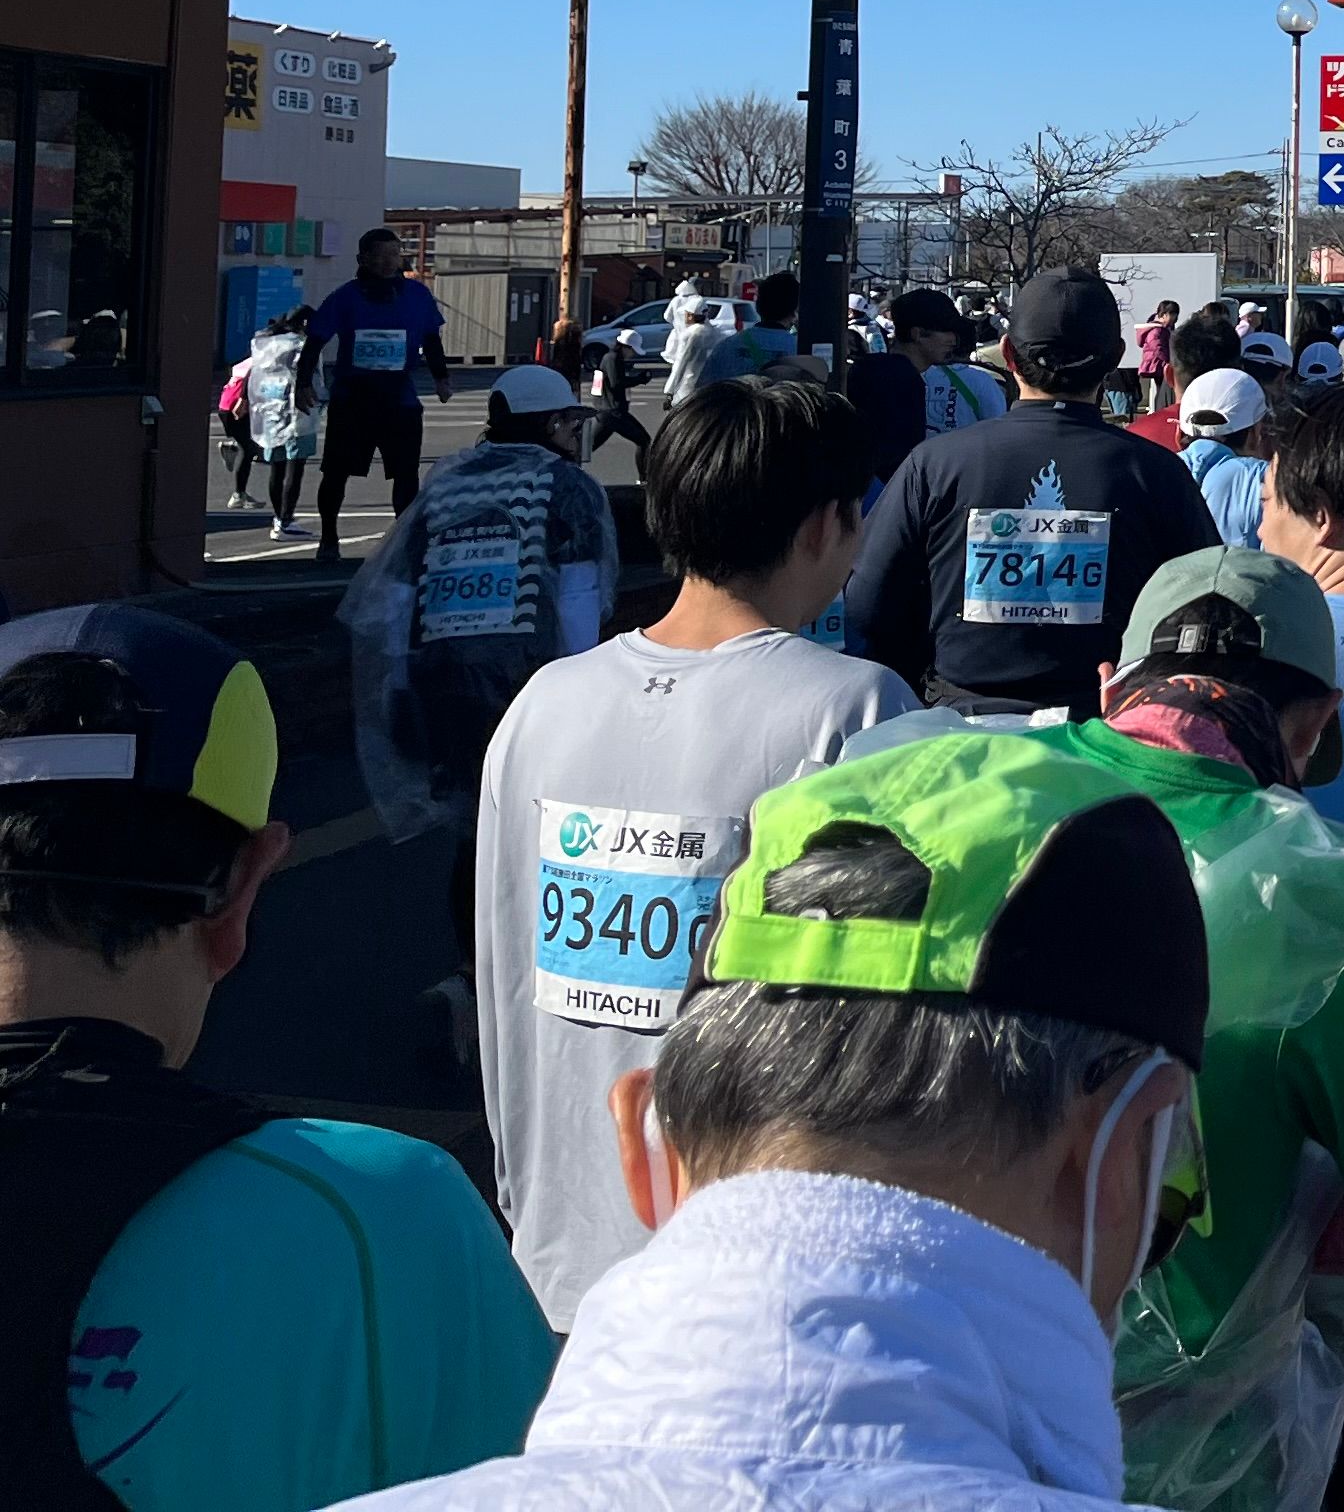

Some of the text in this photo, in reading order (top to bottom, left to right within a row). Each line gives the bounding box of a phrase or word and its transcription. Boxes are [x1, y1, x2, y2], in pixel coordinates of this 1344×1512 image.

[280, 53, 311, 74] くすり
[278, 90, 309, 110] 日用品
[1029, 518, 1090, 535] JX金属
[974, 551, 1103, 588] 7814G
[1002, 606, 1069, 619] HITACHI
[609, 826, 707, 860] JX金属
[566, 987, 661, 1018] HITACHI
